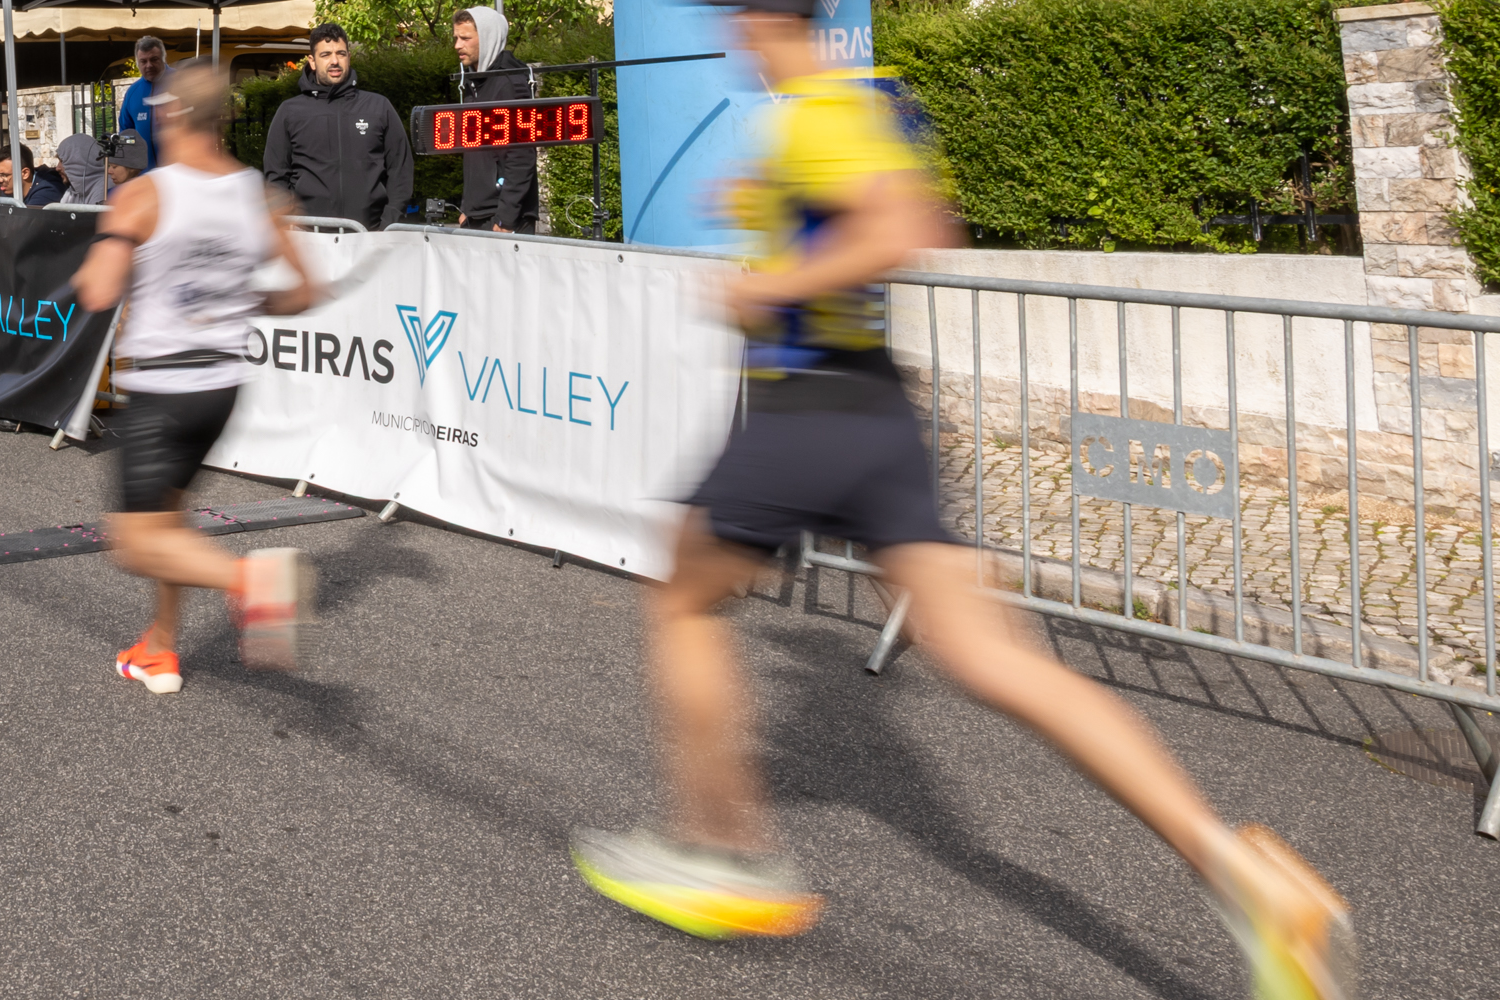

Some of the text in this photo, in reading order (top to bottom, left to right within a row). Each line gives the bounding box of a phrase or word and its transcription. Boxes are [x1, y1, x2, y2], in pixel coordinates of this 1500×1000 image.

[434, 103, 589, 150] 00:34:19
[457, 350, 630, 431] VALLEY
[371, 410, 431, 436] MUNICÍPIO
[1079, 435, 1227, 495] CMO
